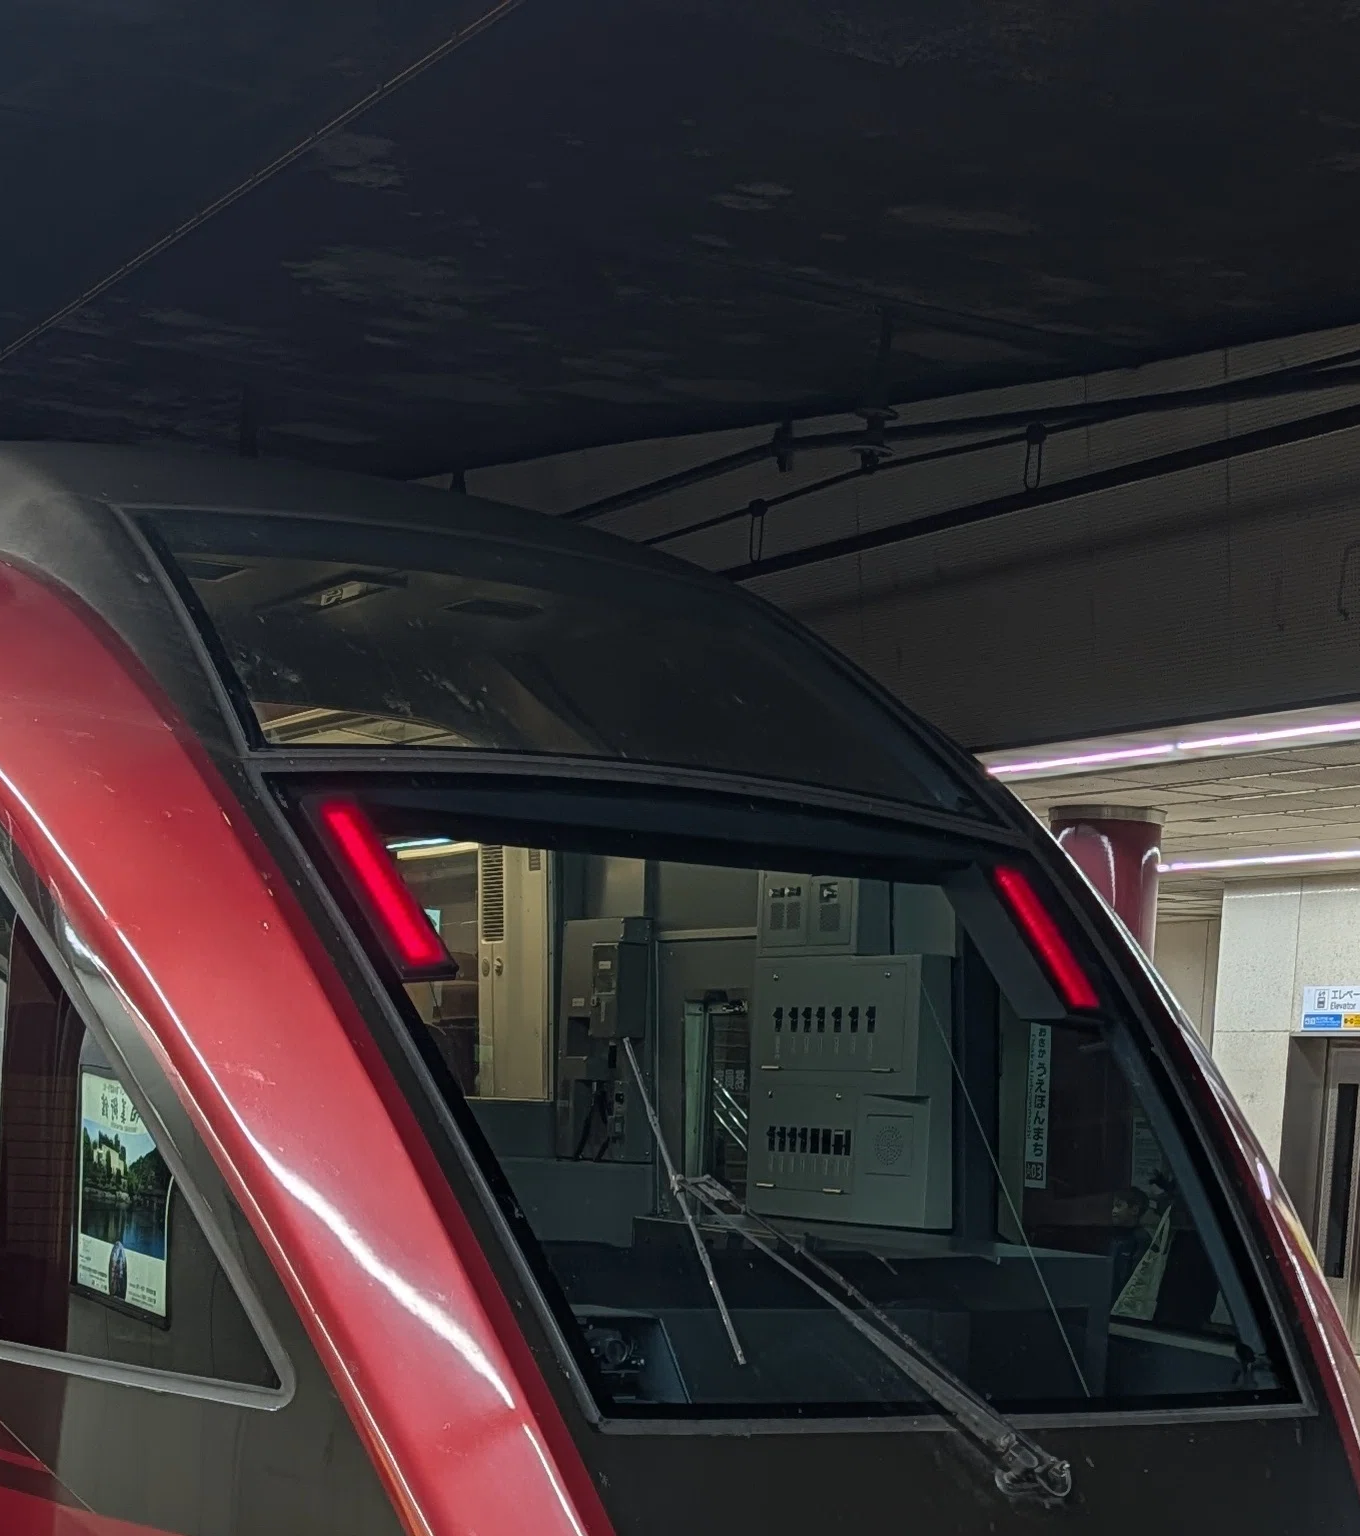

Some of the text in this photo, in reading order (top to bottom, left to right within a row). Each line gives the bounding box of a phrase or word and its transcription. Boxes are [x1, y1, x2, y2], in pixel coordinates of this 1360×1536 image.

[1330, 1001, 1357, 1010] Elevator
[1033, 1062, 1048, 1157] うえほんまち
